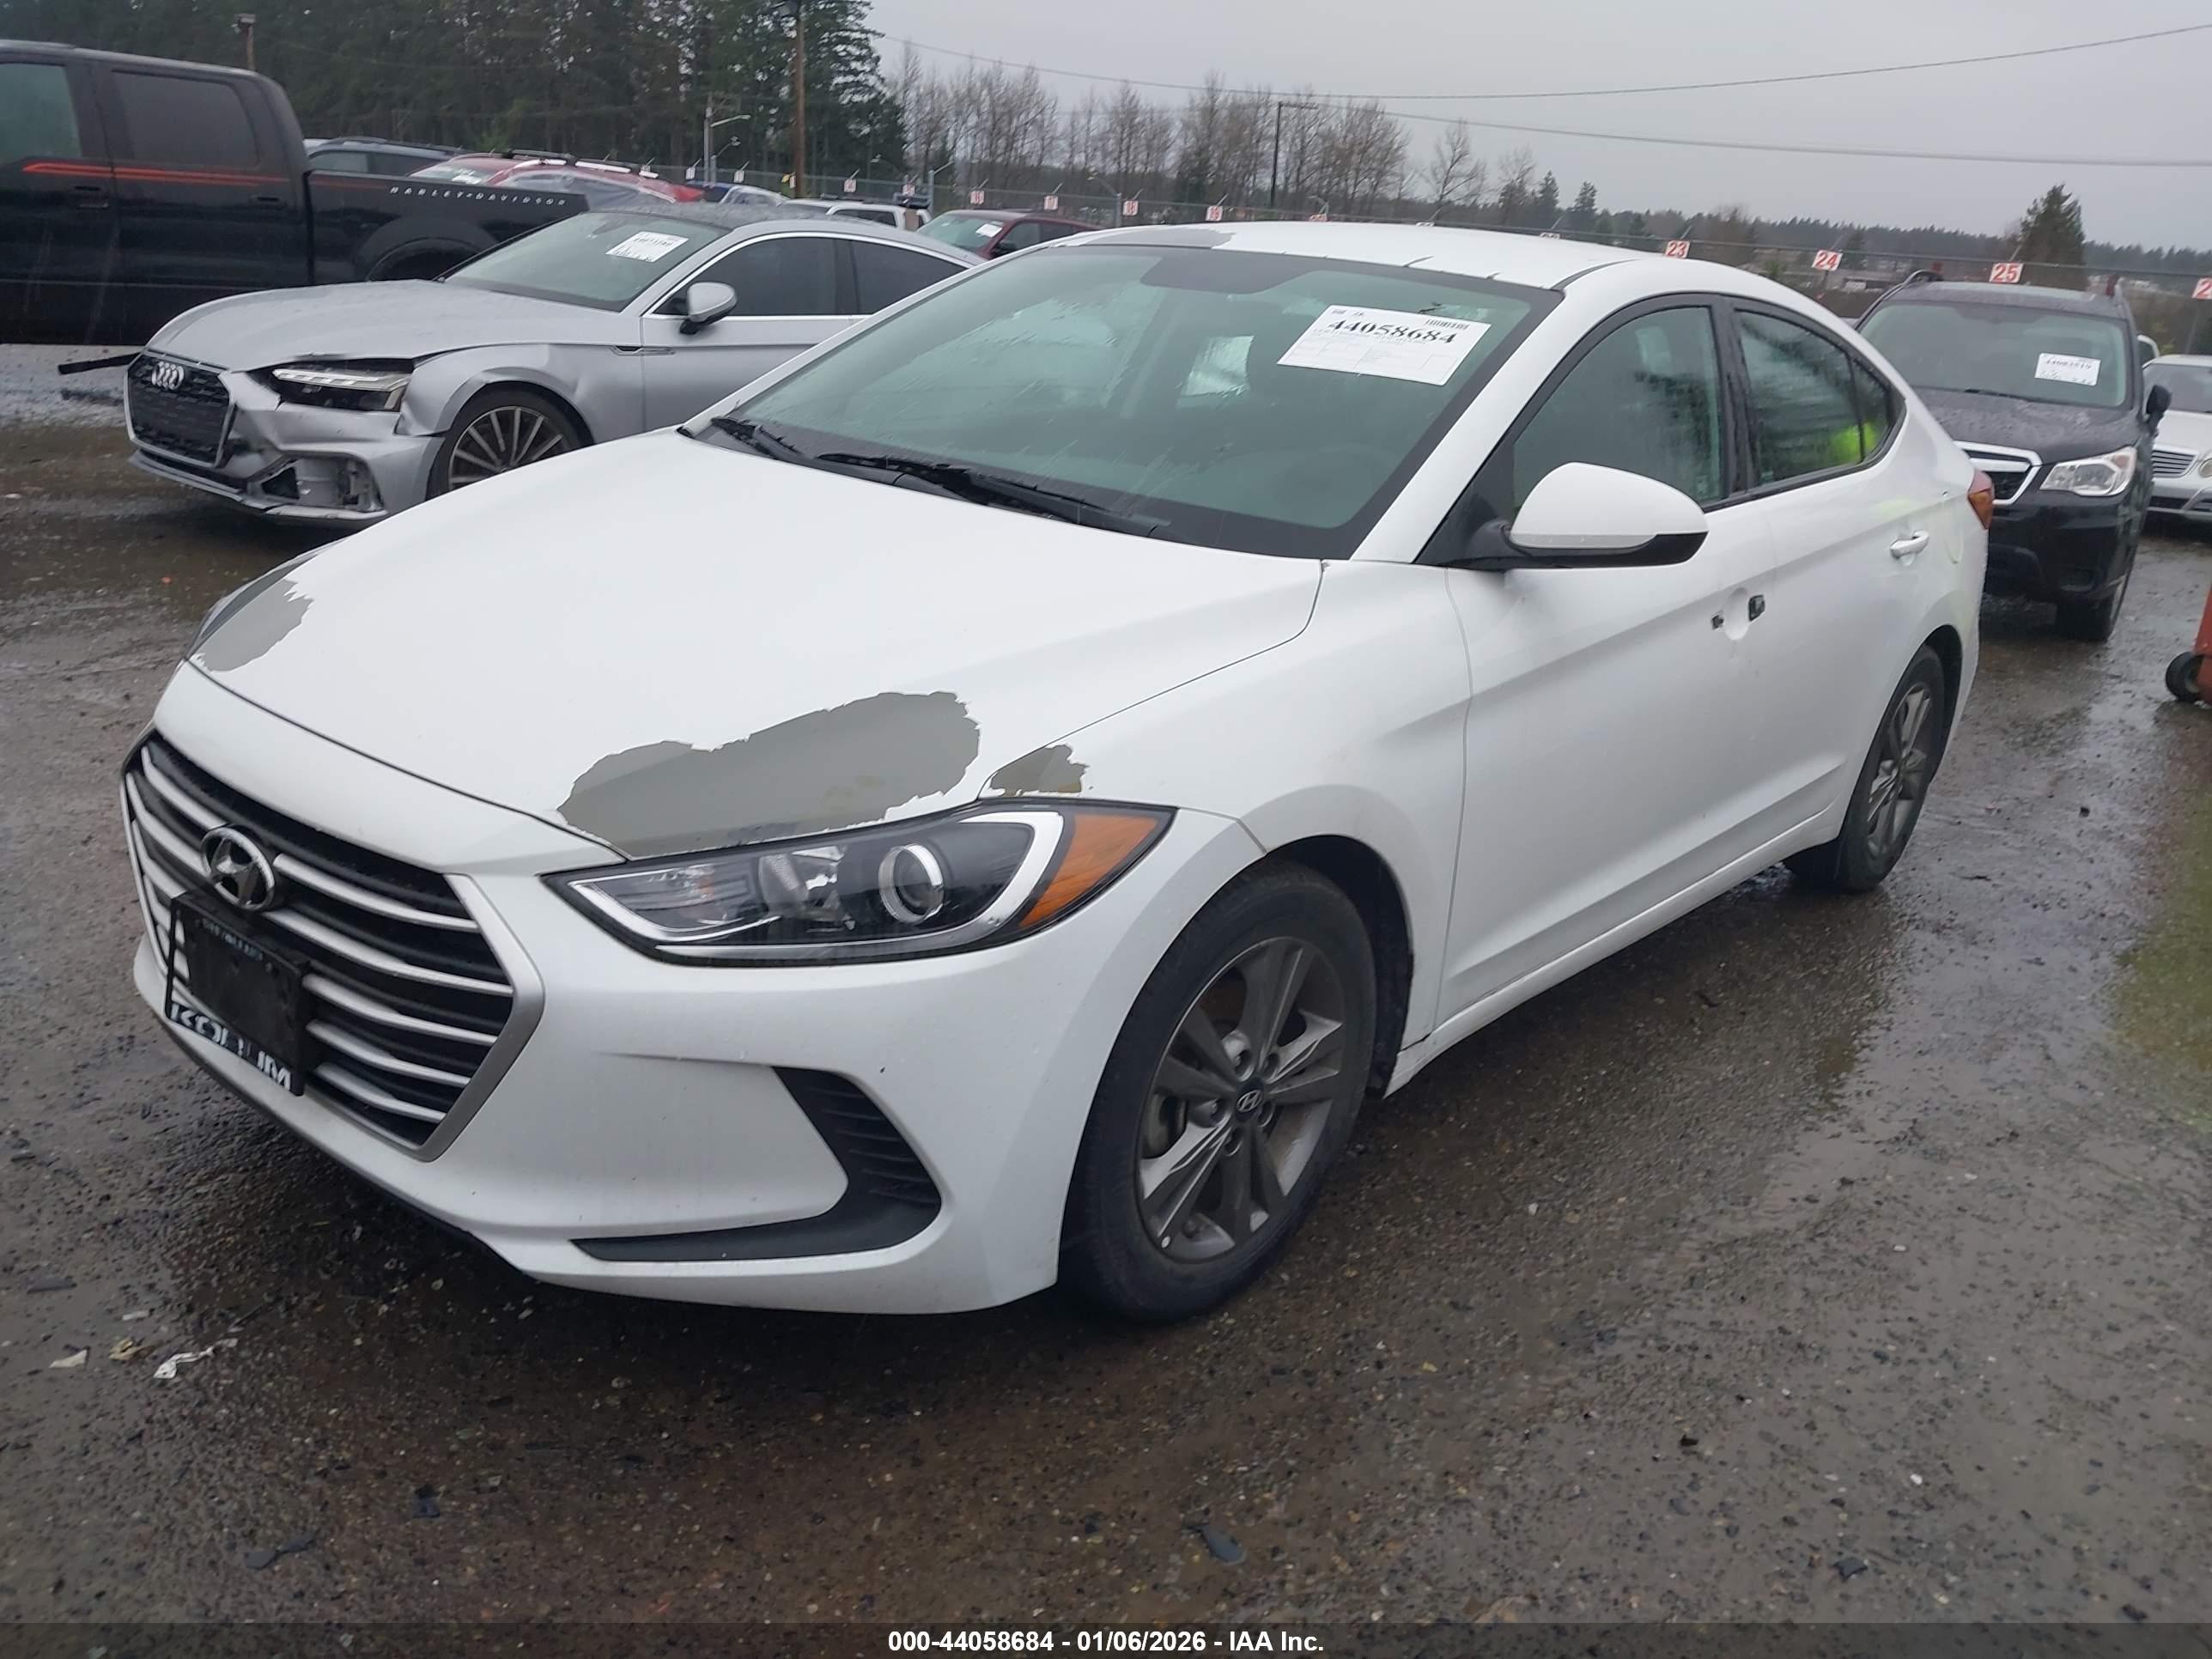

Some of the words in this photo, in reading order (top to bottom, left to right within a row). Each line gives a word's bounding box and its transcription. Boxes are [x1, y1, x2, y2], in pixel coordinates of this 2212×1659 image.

[1668, 241, 1686, 257] 23
[1815, 252, 1838, 269] 24
[1993, 264, 2018, 282] 25
[2197, 279, 2212, 299] 2
[1328, 319, 1457, 343] 44058684
